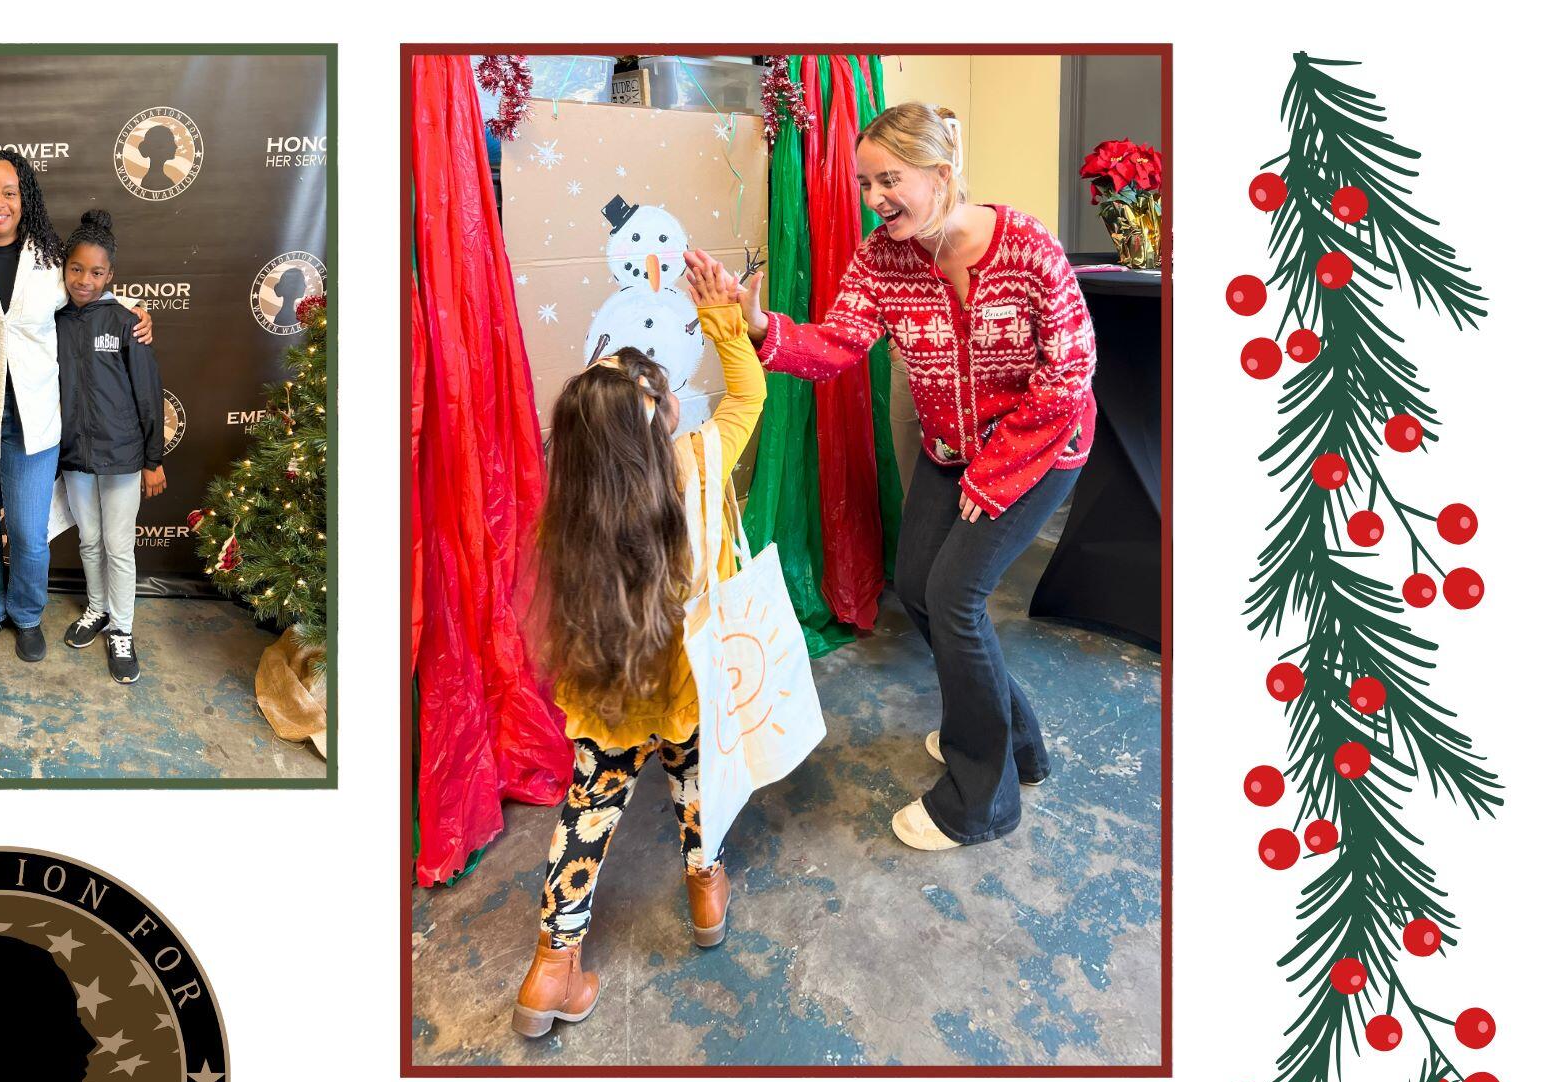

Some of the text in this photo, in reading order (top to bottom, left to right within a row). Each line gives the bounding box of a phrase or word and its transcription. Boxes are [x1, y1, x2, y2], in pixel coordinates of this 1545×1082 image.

[118, 109, 200, 145] FOUNDATION FOR
[266, 154, 326, 167] HER SERV
[116, 163, 200, 200] WOMEN WARRIORS
[256, 252, 314, 286] FOUNDATION
[114, 283, 190, 298] HONOR
[146, 299, 190, 310] ERVICE
[252, 304, 279, 333] WOMEN
[169, 396, 182, 413] FOR
[135, 526, 190, 538] OWER
[137, 539, 171, 548] UTURE
